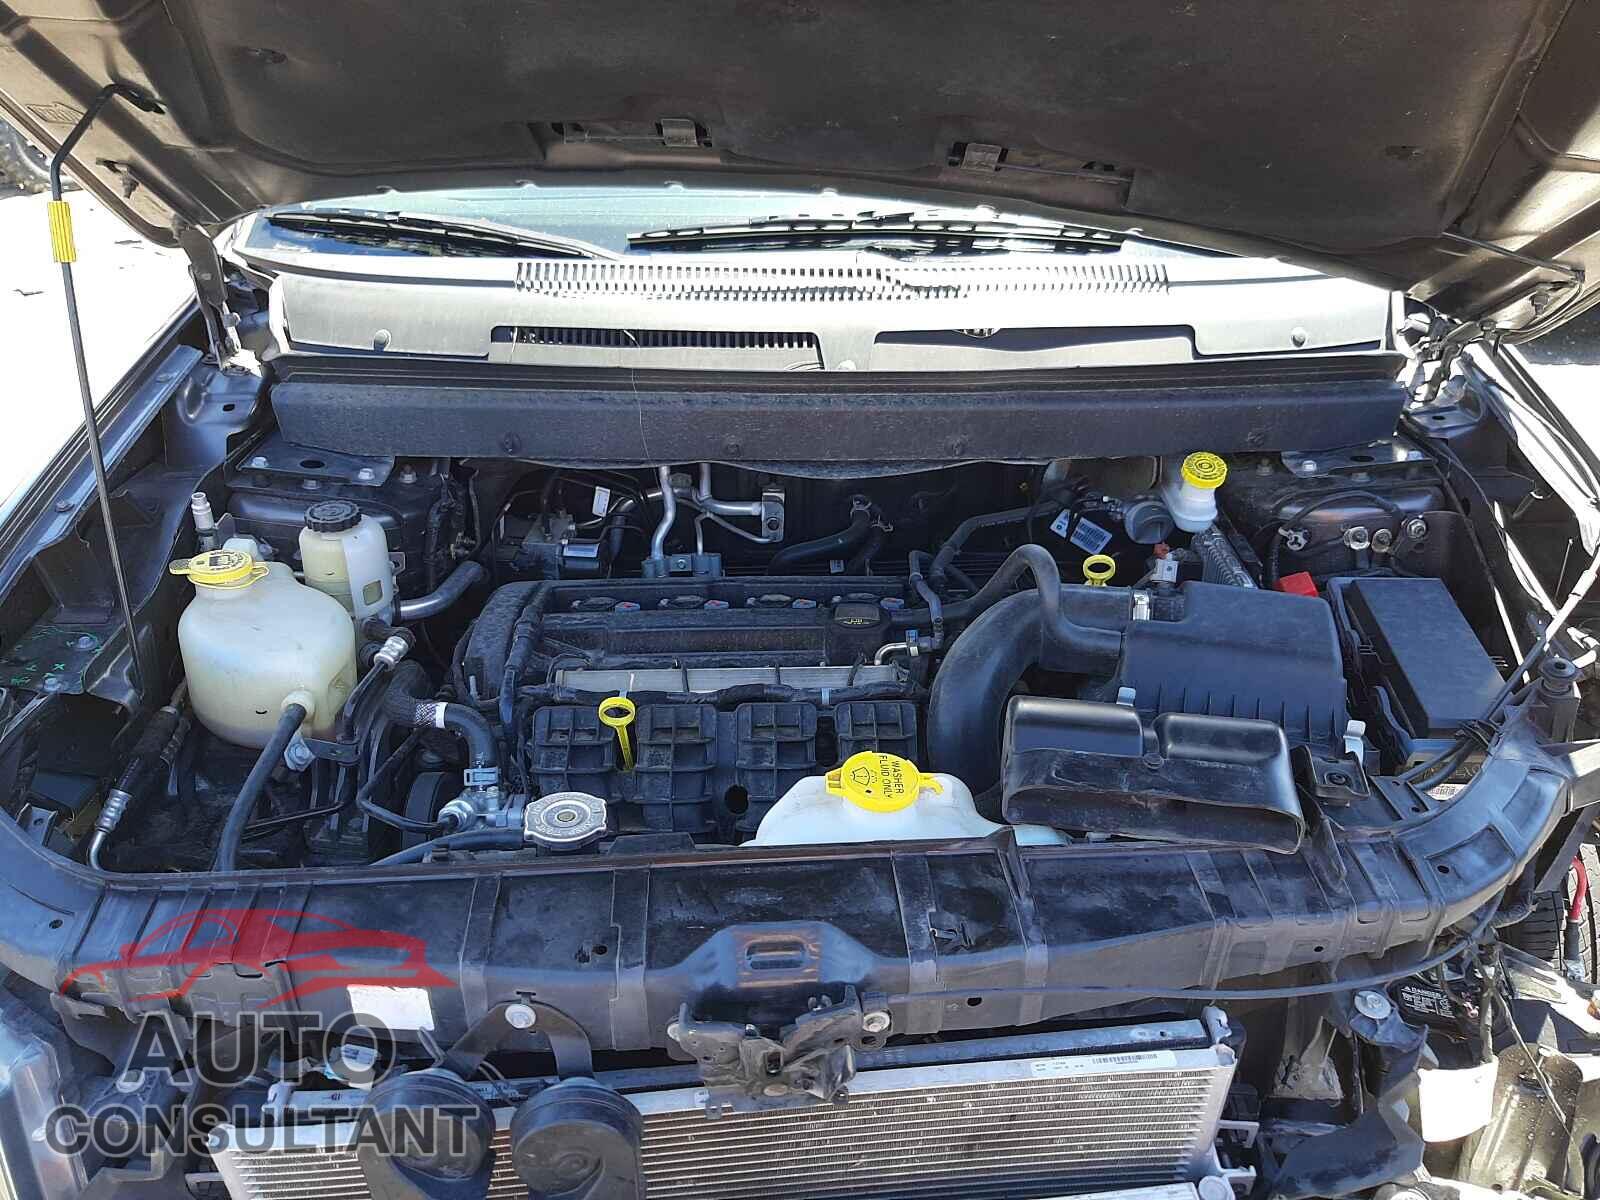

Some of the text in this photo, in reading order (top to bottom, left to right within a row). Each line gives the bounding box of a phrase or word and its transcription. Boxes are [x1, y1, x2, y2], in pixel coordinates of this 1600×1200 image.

[879, 755, 893, 799] FLUID ONLY
[891, 760, 905, 794] WASHER
